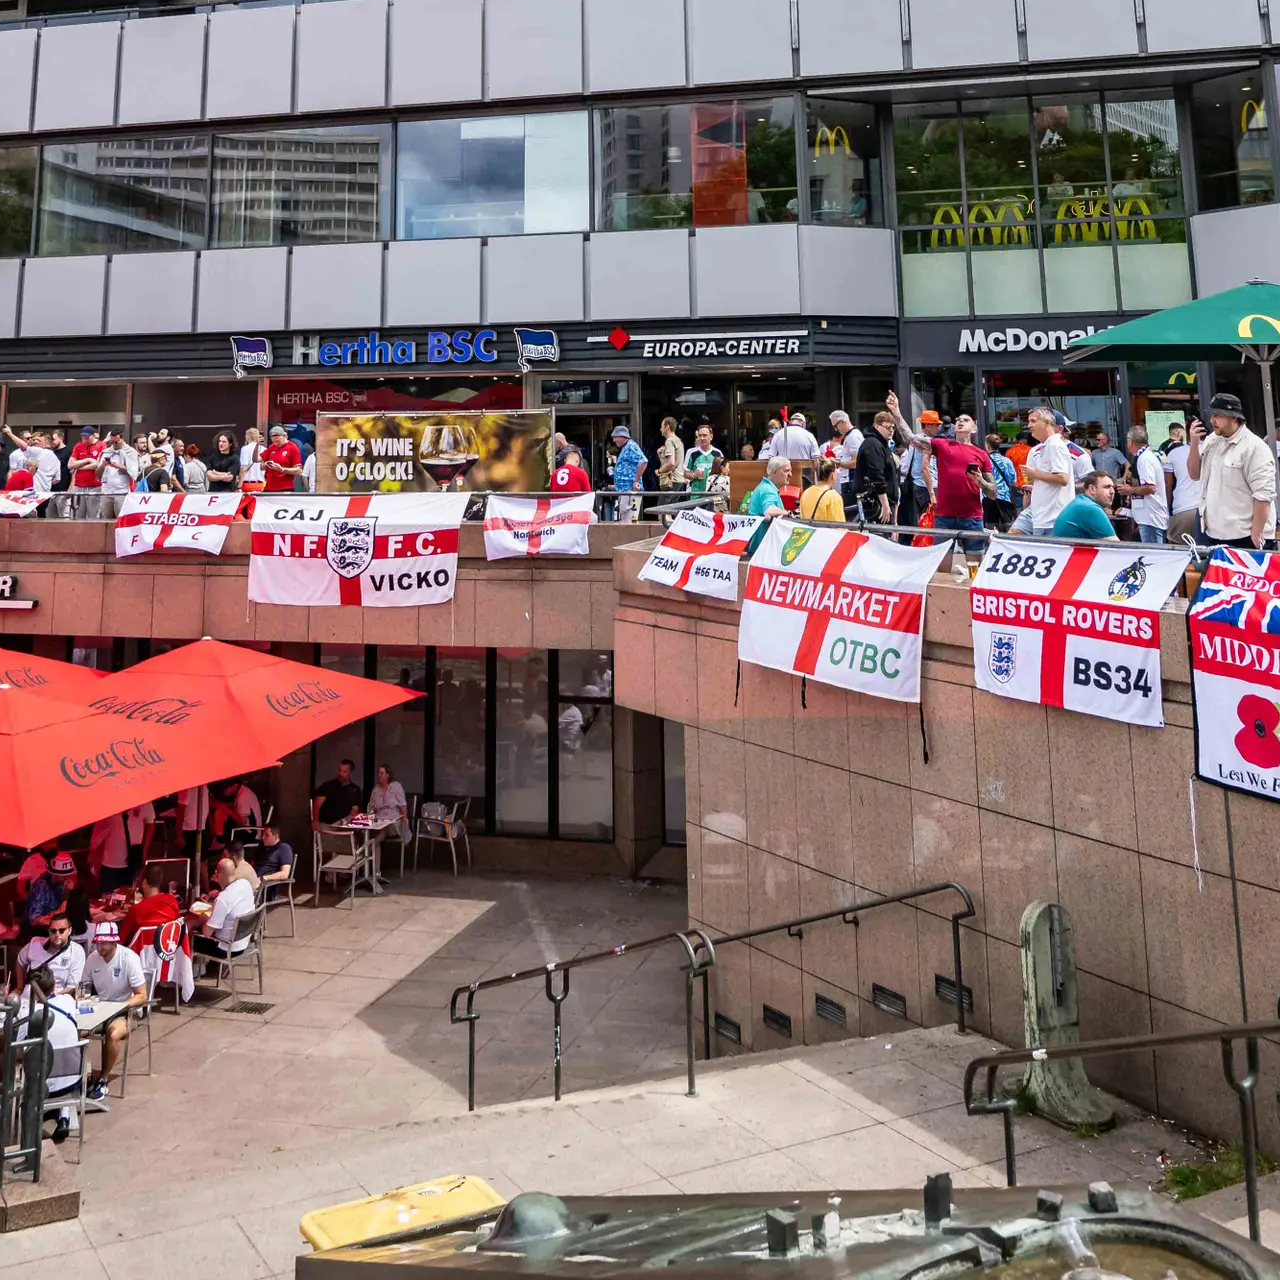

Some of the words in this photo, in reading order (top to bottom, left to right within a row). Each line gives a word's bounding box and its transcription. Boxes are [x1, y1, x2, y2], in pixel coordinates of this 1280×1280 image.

[291, 331, 416, 366] Hertha
[428, 330, 498, 364] BSC
[643, 338, 800, 358] EUROPA-CENTER
[958, 328, 1096, 352] McDona
[276, 392, 323, 406] HERTHA
[325, 391, 349, 405] BSC
[335, 438, 366, 458] IT'S
[370, 438, 414, 458] WINE
[335, 461, 414, 482] O'CLOCK!
[556, 468, 570, 486] 6
[143, 511, 199, 526] STABBO
[273, 508, 326, 523] CAJ
[513, 526, 555, 540] Nantwich
[387, 532, 442, 558] F.C.
[650, 554, 679, 573] TEAM
[986, 552, 1057, 580] 1883
[369, 568, 450, 593] VICKO
[711, 567, 732, 583] TAA
[756, 572, 900, 626] NEWMARKET
[972, 593, 1056, 624] BRISTOL
[1062, 607, 1153, 641] ROVERS
[828, 636, 902, 680] OTBC
[1072, 657, 1153, 699] BS34
[1218, 763, 1245, 785] Lest
[1248, 773, 1269, 791] We
